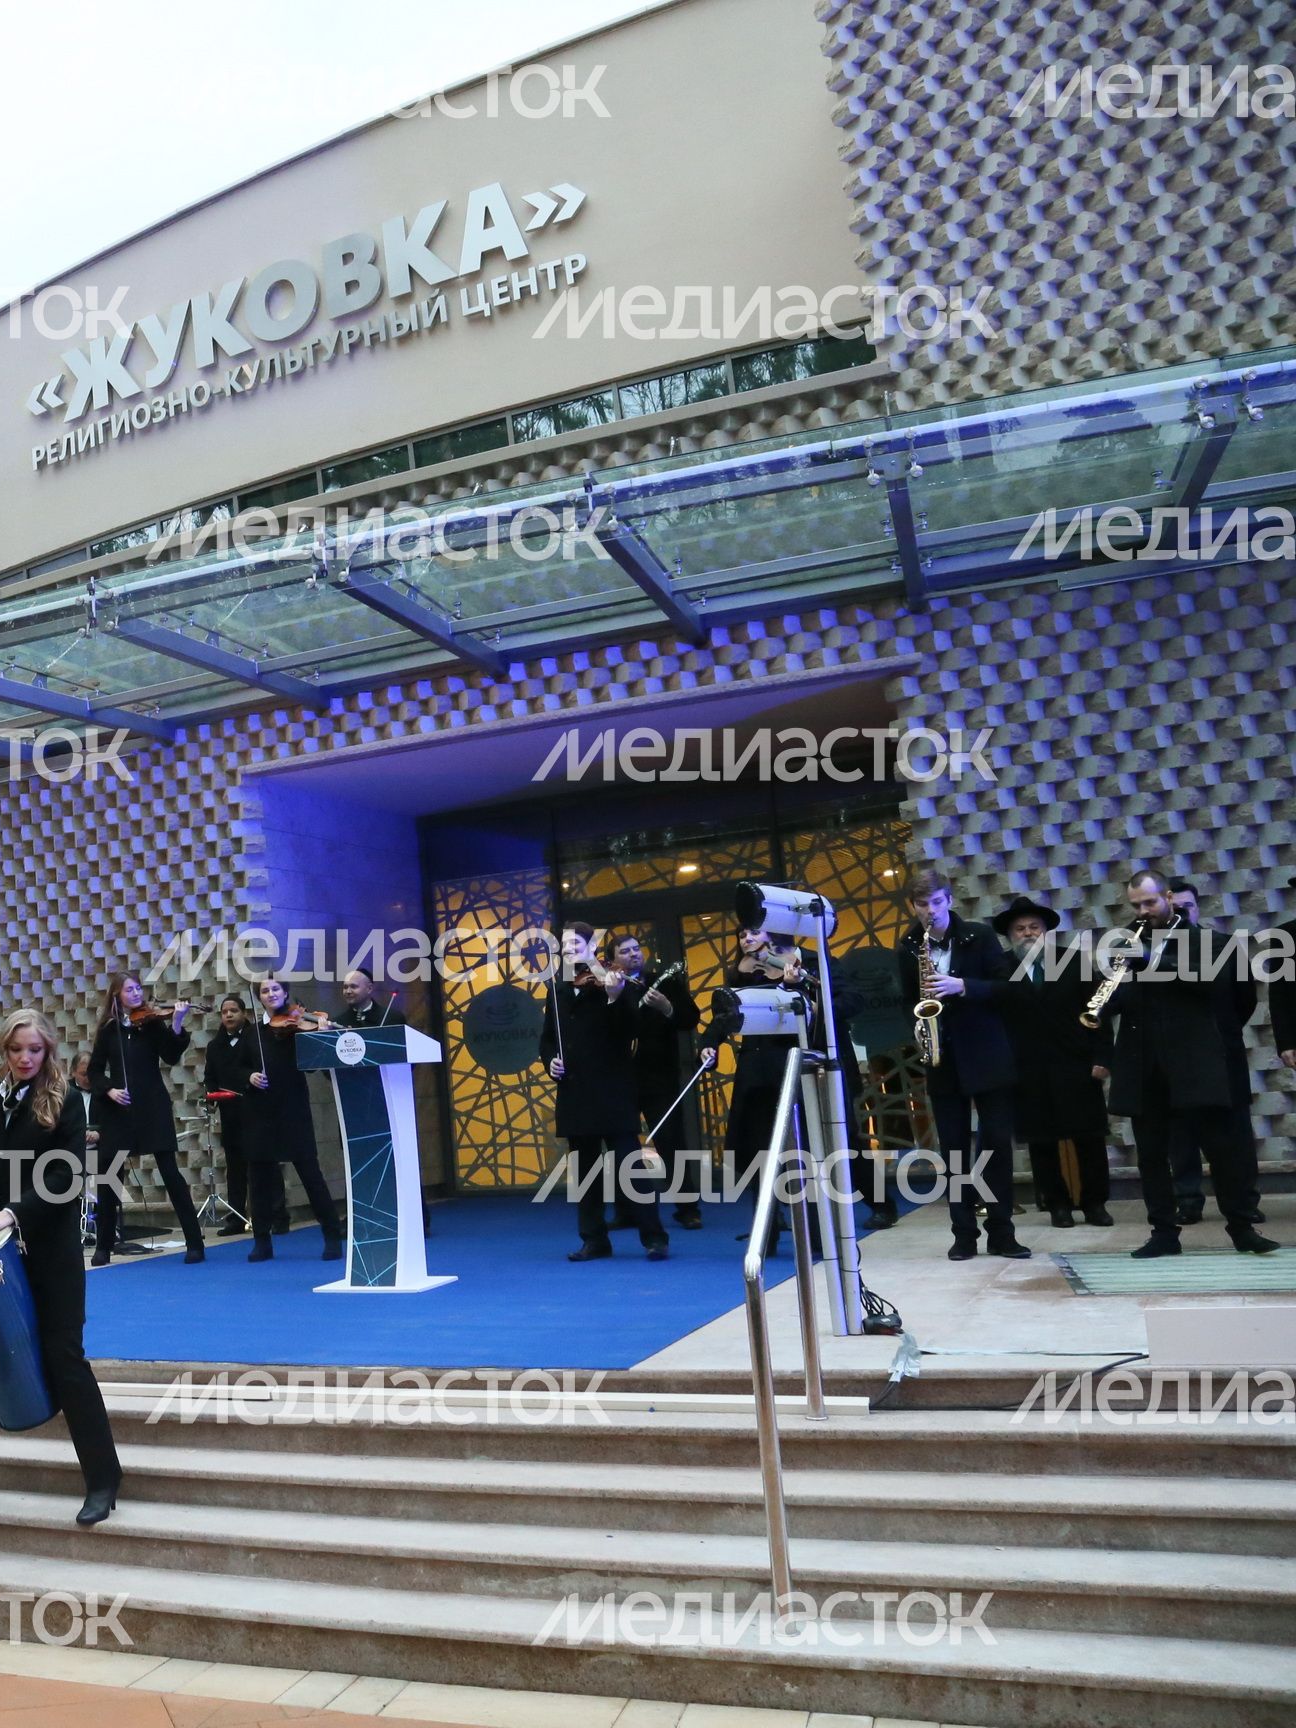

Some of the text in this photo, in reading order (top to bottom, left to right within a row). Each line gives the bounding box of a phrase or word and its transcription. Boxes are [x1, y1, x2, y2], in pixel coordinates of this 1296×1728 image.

[26, 182, 587, 423] «ЖУКОВКА»
[31, 253, 588, 471] РЕЛИГИОЗНО-КУЛЬТУРНЫЙ ЦЕНТР
